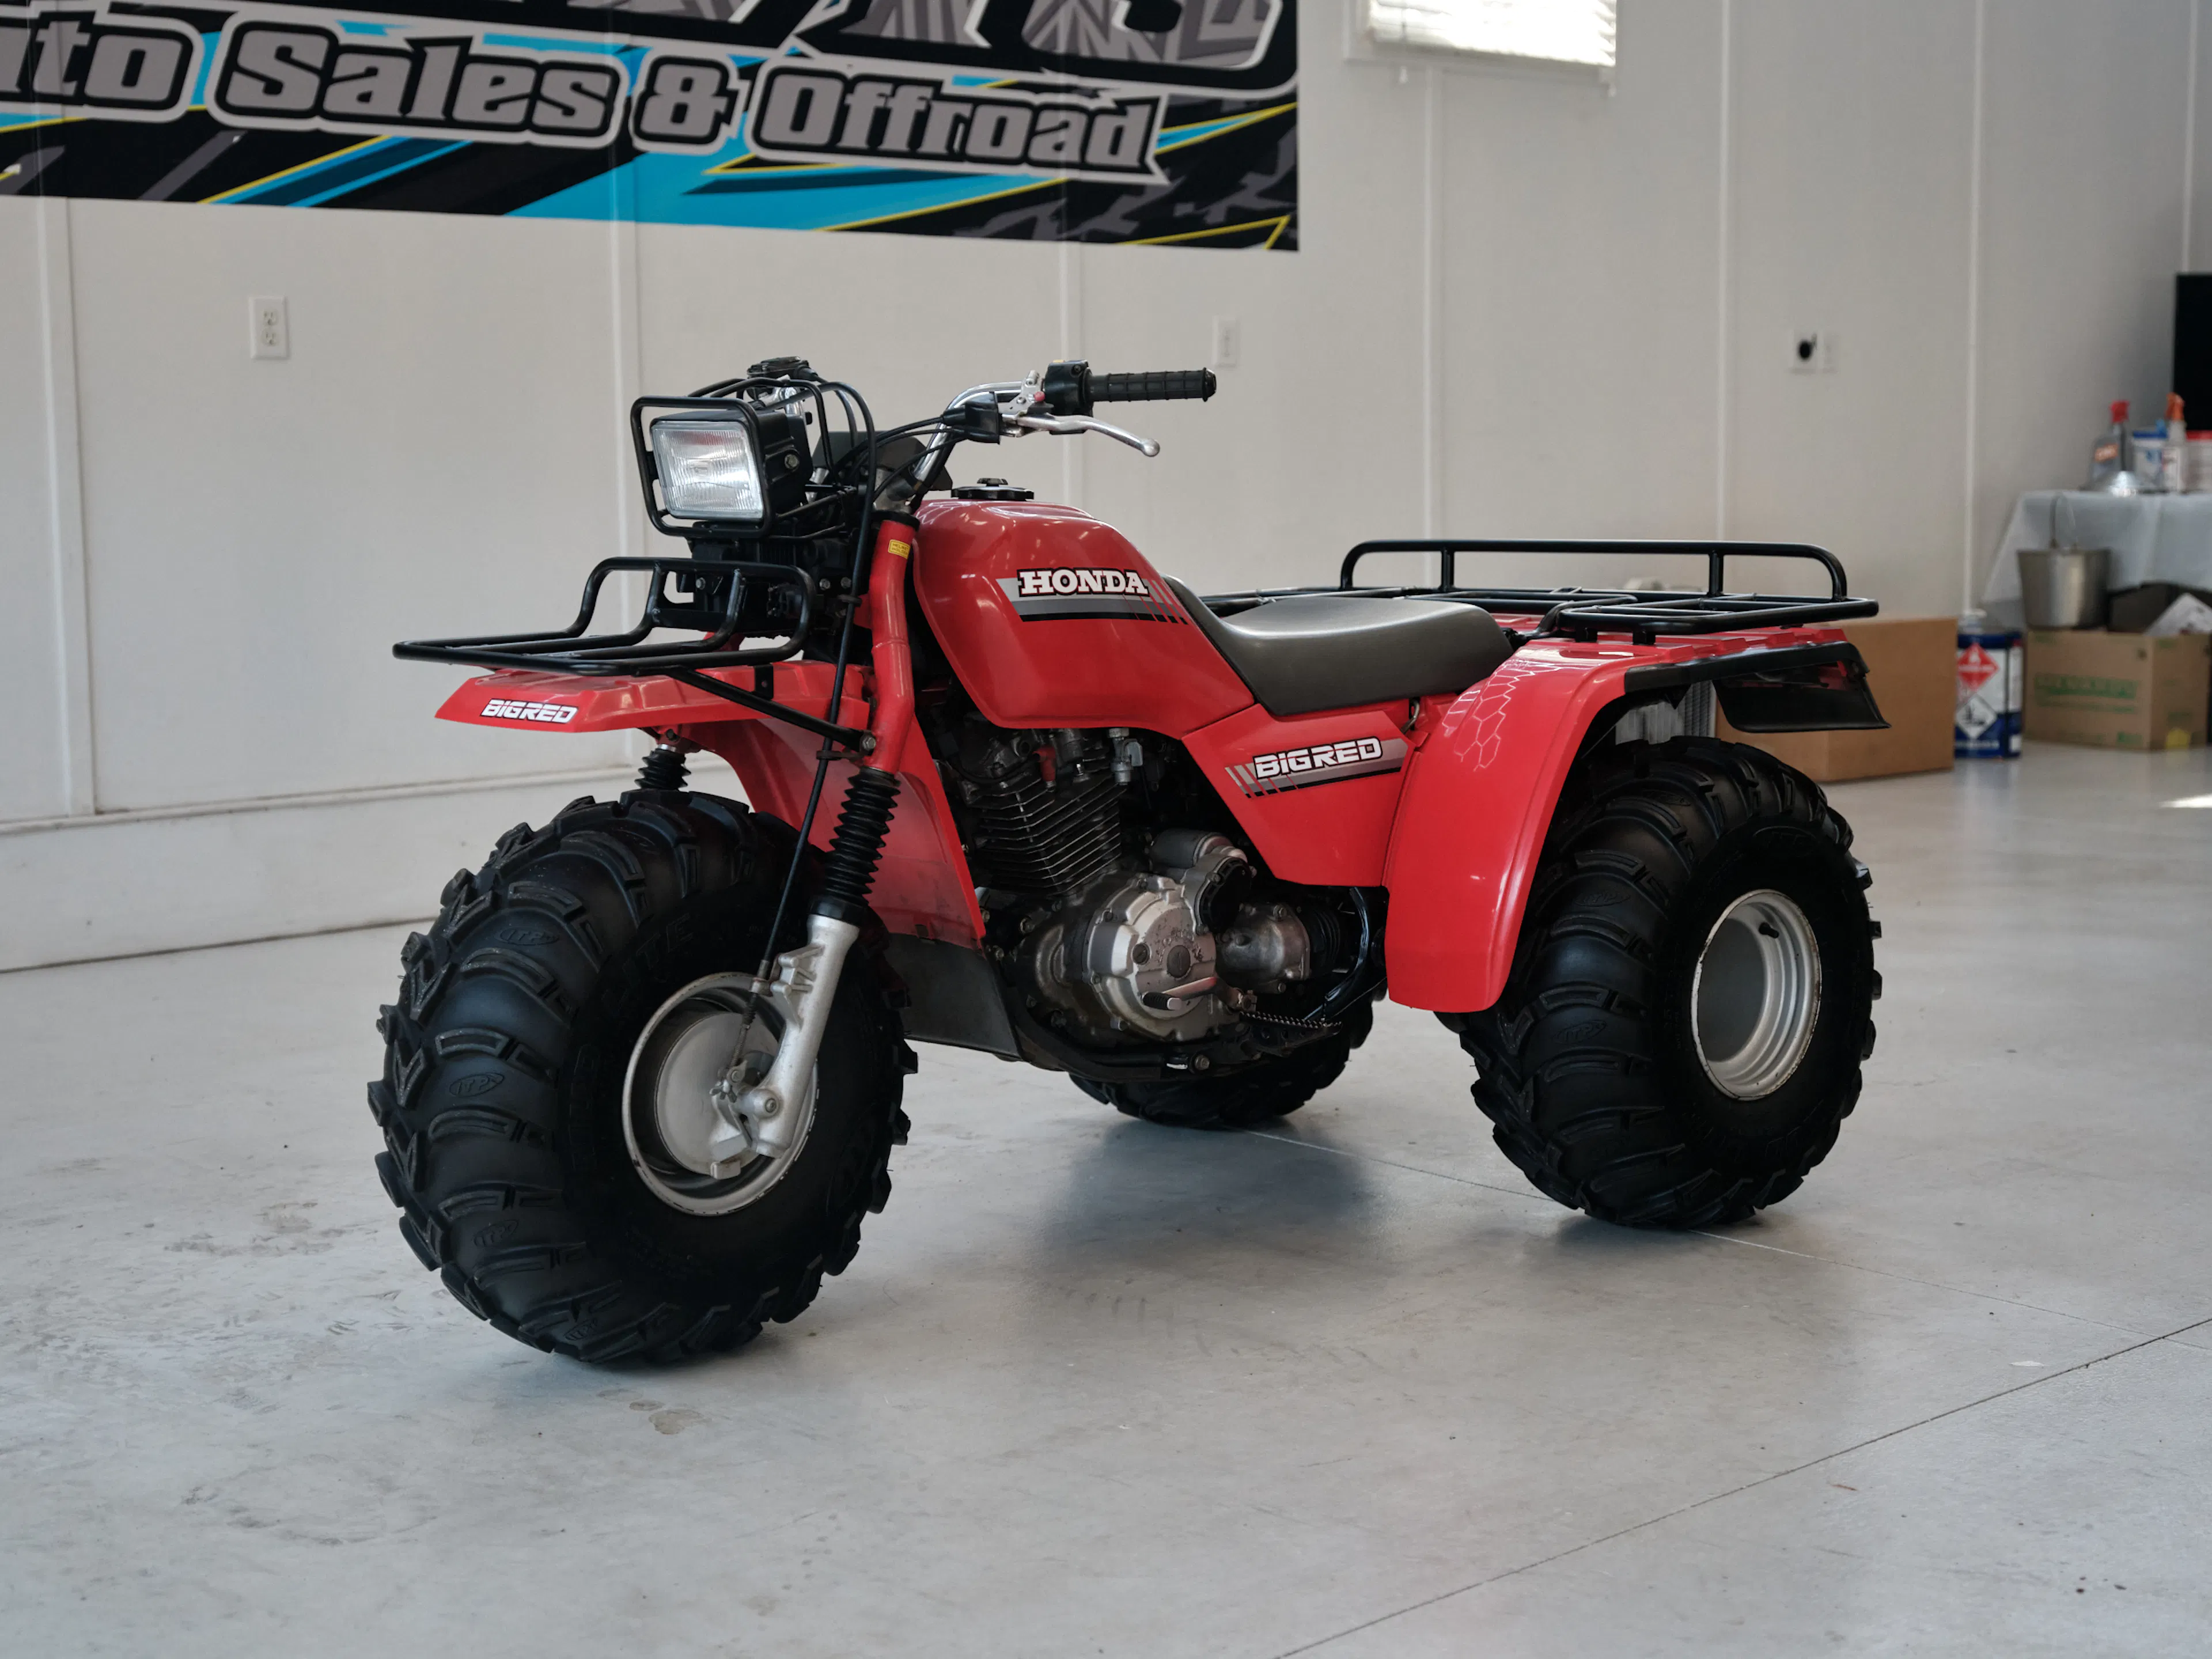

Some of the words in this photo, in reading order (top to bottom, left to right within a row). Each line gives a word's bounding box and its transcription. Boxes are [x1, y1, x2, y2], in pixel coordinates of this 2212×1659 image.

[222, 26, 613, 132] Sales
[637, 60, 730, 141] &
[755, 69, 1155, 170] Offroad
[1018, 569, 1149, 596] HONDA
